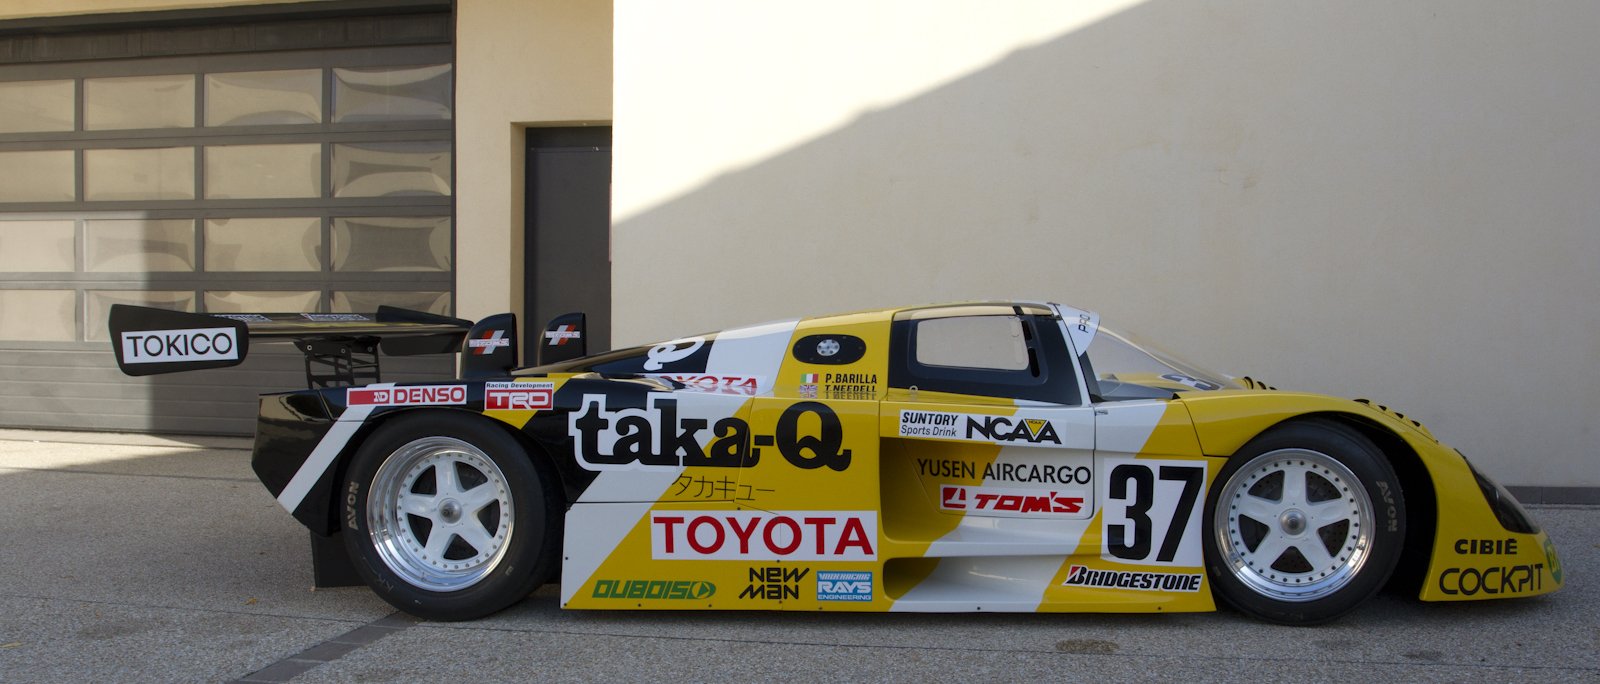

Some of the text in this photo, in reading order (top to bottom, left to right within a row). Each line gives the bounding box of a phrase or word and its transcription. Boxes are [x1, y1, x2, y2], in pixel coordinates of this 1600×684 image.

[126, 332, 233, 358] TOKICO
[825, 373, 877, 384] P.BARILLA
[393, 386, 465, 403] DENSO
[900, 424, 957, 437] Sports Drink
[902, 411, 959, 426] SUNTORY
[568, 393, 852, 472] taka-Q
[917, 458, 1092, 485] YUSEN AIRCARGO
[671, 473, 776, 501] タカキュー
[347, 480, 360, 531] AVON
[974, 491, 1084, 513] TOM'S
[1107, 463, 1204, 562] 37
[1376, 480, 1398, 533] AVON
[653, 515, 875, 556] TOYOTA
[817, 581, 872, 593] RAYS
[1066, 566, 1202, 591] BRIDGESTONE
[1438, 563, 1544, 596] COCKPIT
